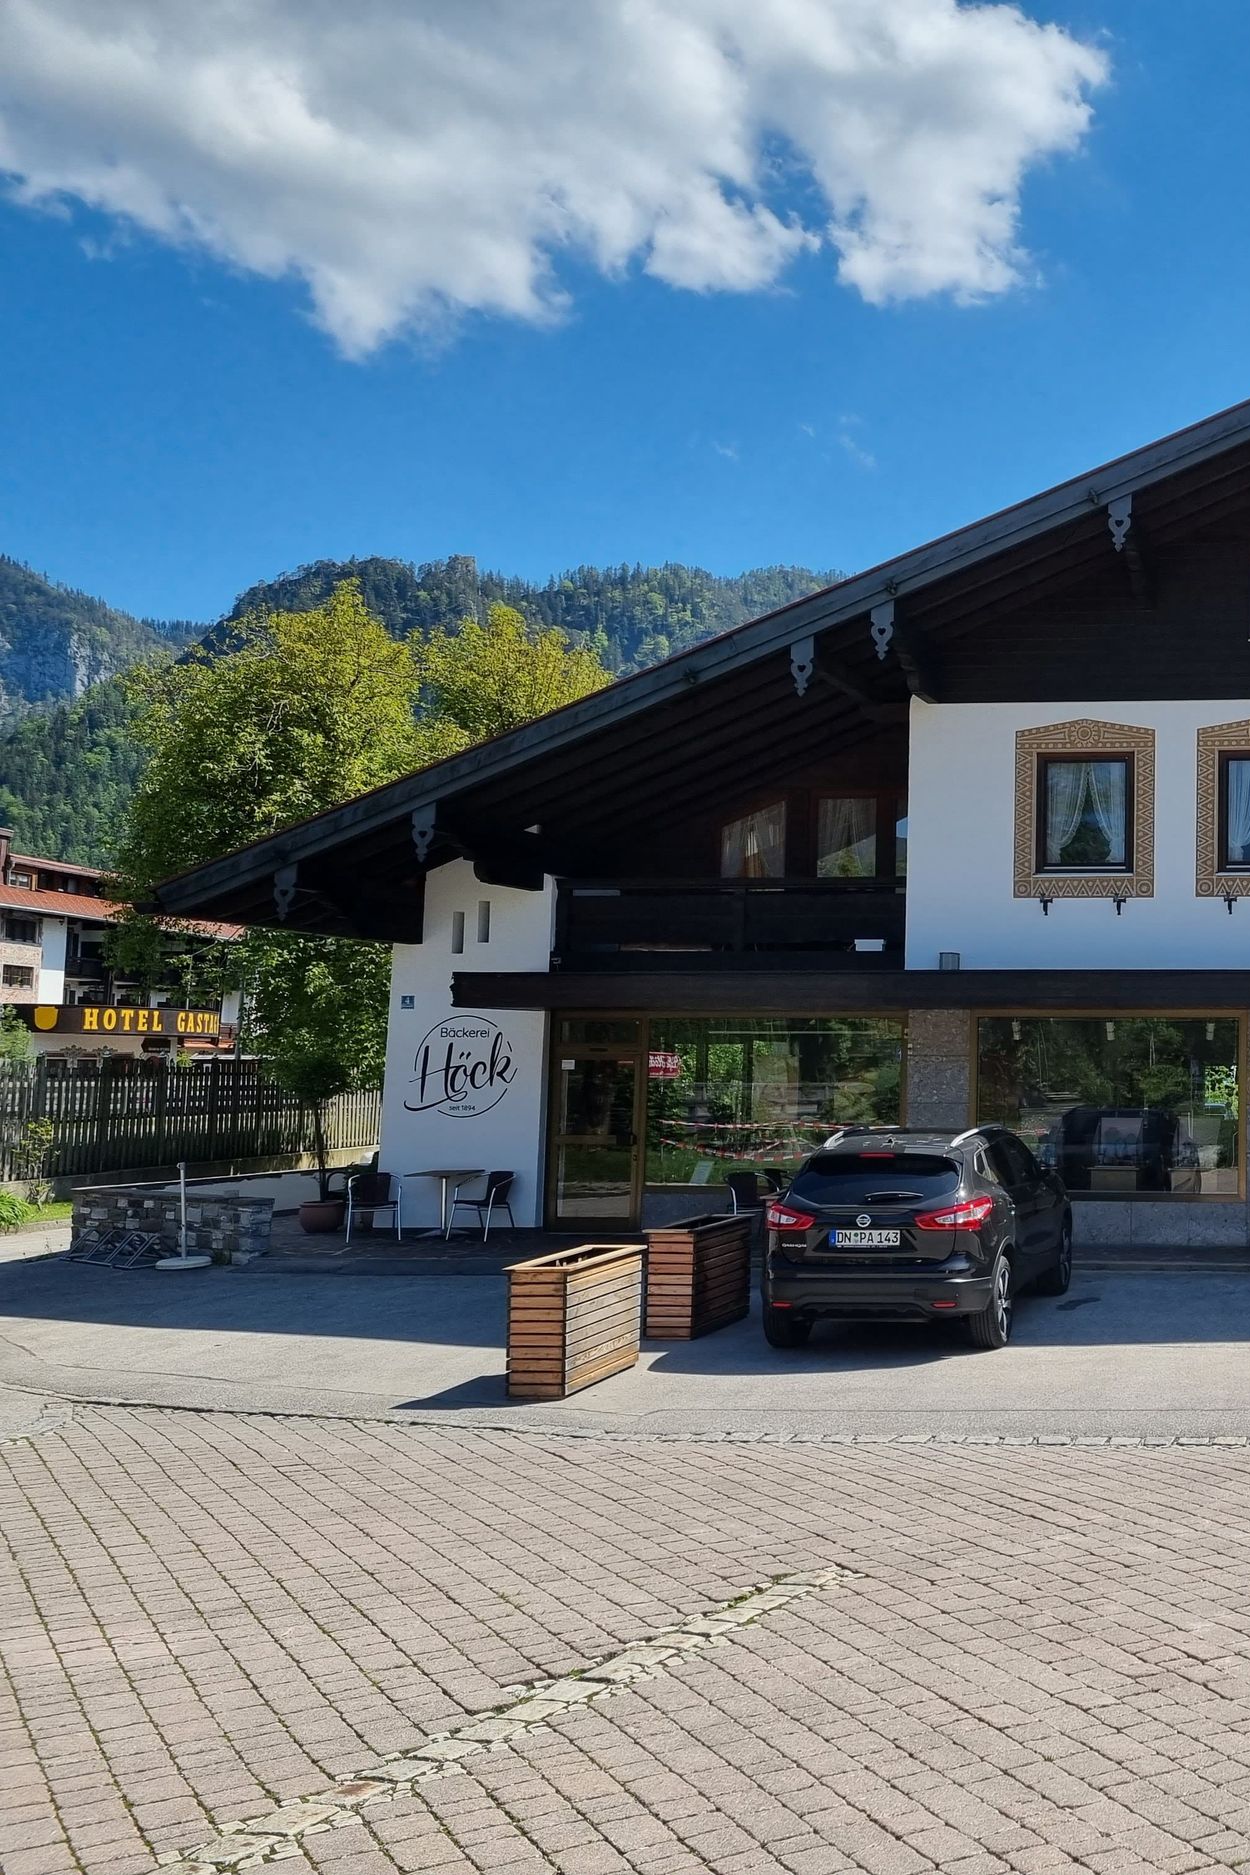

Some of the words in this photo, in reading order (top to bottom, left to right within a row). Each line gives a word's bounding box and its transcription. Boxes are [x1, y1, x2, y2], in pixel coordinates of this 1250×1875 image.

[83, 1007, 163, 1032] HOTEL
[440, 1026, 490, 1038] Bäckerei
[404, 1031, 518, 1111] Höck
[836, 1231, 852, 1243] DN
[859, 1231, 874, 1243] PA
[877, 1231, 899, 1243] 143
